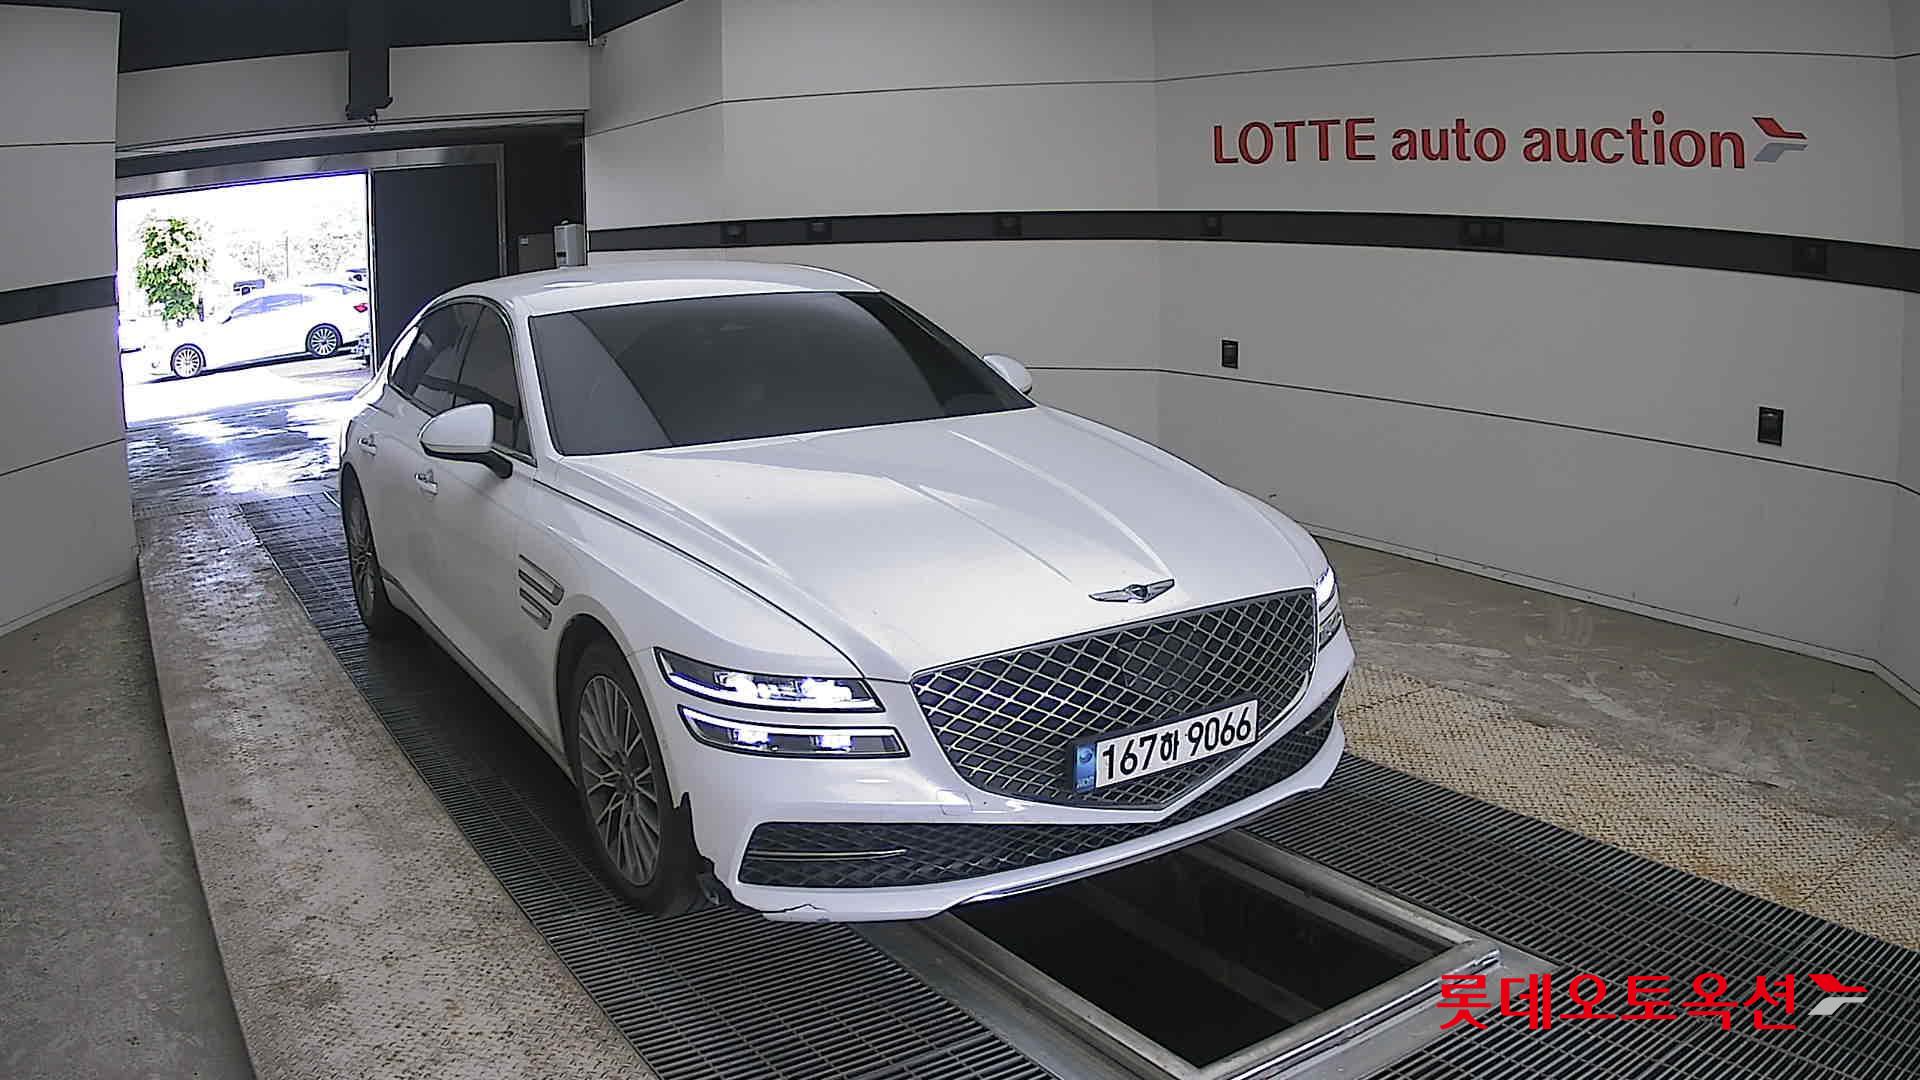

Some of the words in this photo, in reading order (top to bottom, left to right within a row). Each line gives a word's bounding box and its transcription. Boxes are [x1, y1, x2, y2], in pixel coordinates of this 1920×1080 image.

[1213, 118, 1376, 164] LOTTE
[1391, 118, 1507, 162] auto
[1522, 110, 1745, 169] auction
[1102, 729, 1180, 780] 167하
[1187, 706, 1252, 757] 9066
